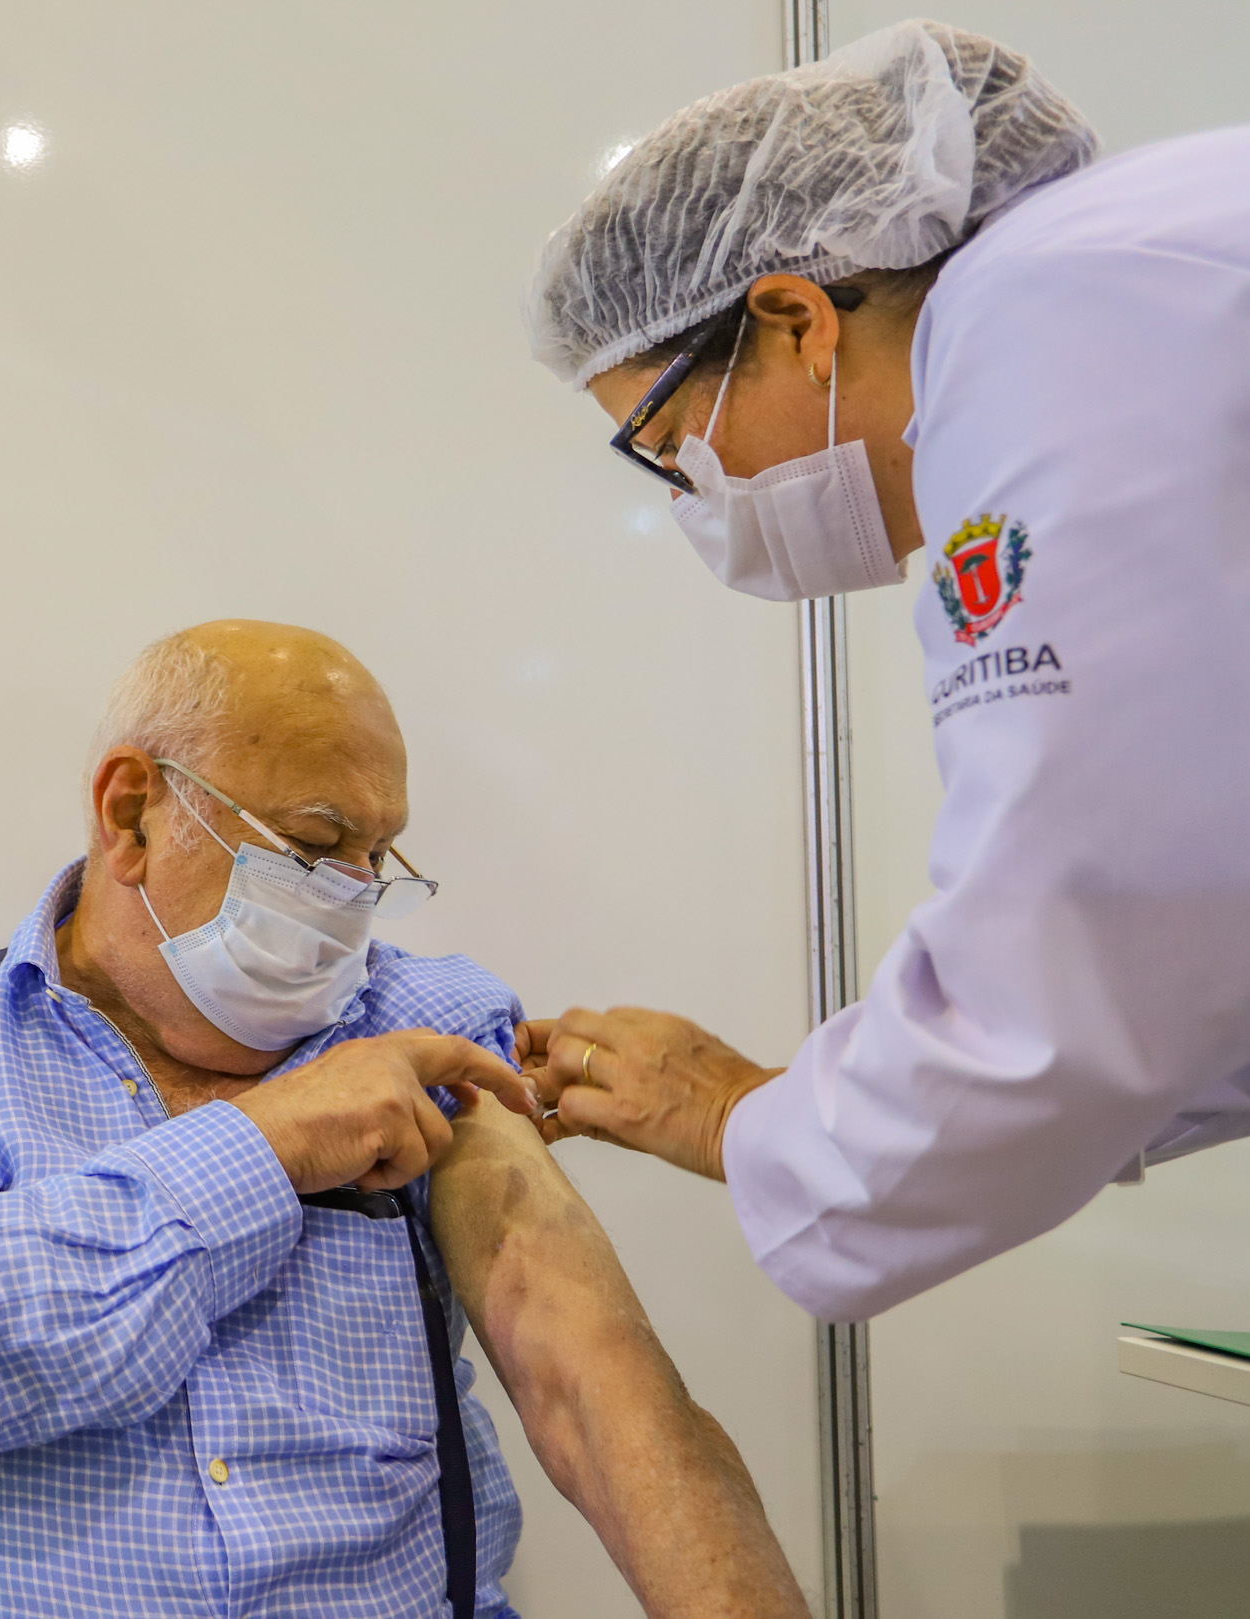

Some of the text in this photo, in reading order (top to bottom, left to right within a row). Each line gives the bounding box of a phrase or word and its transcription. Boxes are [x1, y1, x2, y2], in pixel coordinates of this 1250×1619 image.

[932, 644, 1061, 704] CURITIBA
[984, 689, 1003, 703] DA
[1007, 678, 1071, 698] SAÚDE
